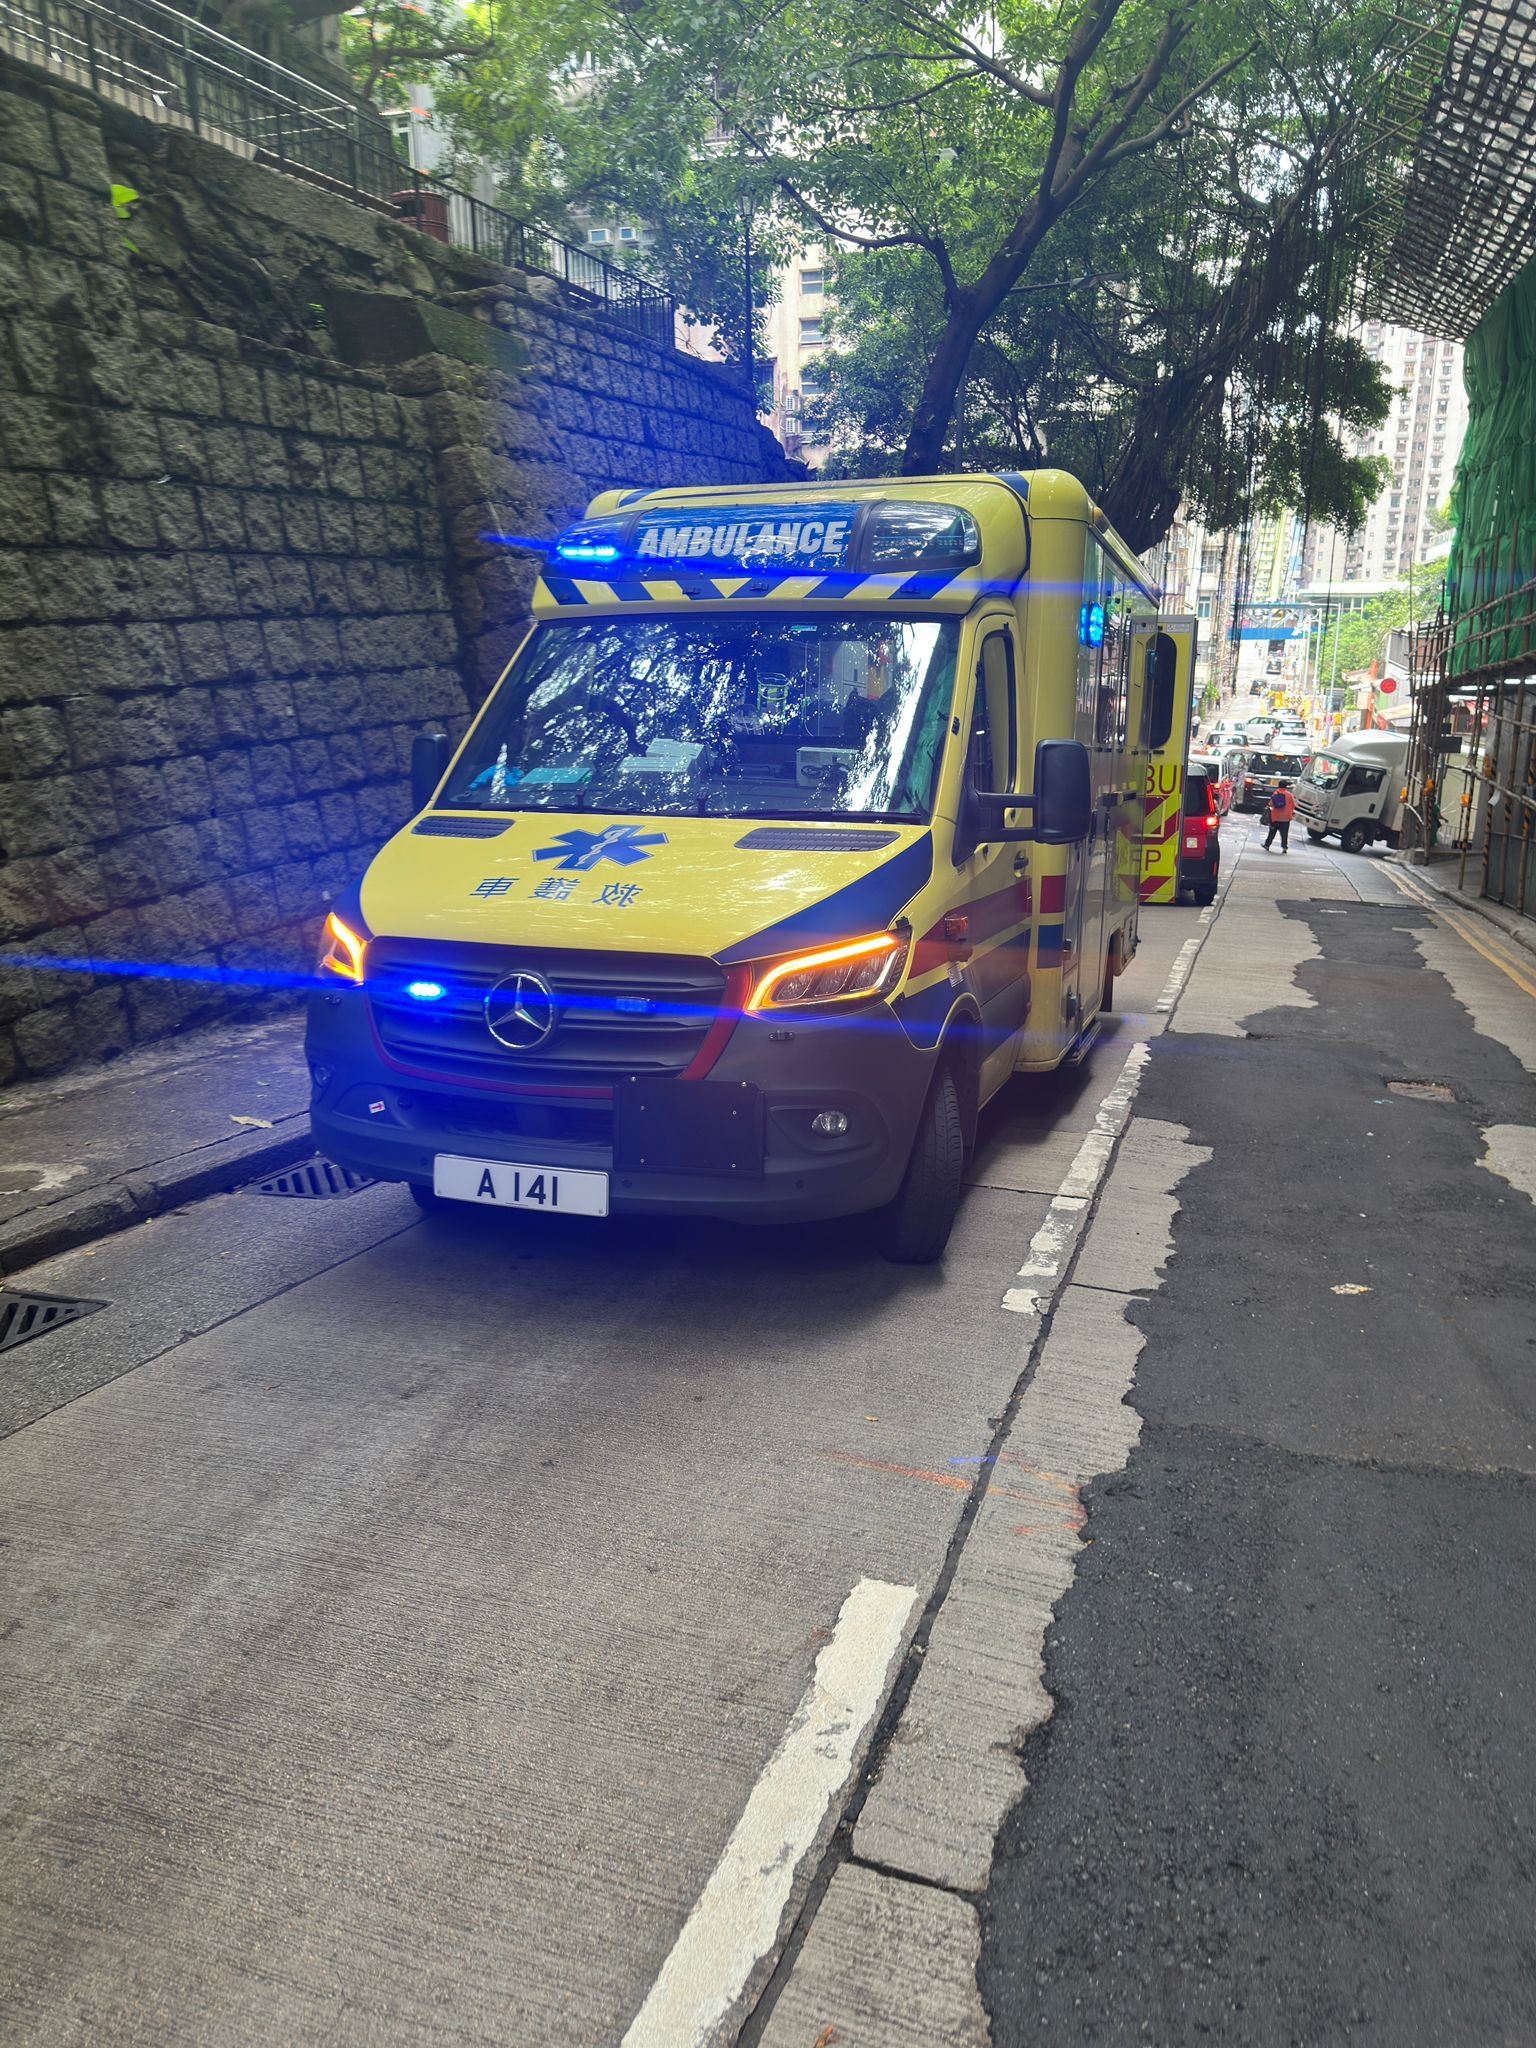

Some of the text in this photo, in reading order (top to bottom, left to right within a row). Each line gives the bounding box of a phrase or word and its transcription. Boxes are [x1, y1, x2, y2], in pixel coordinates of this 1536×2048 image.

[637, 520, 847, 558] AMBULANCE
[1146, 764, 1184, 794] BU
[477, 1168, 558, 1206] A 141
